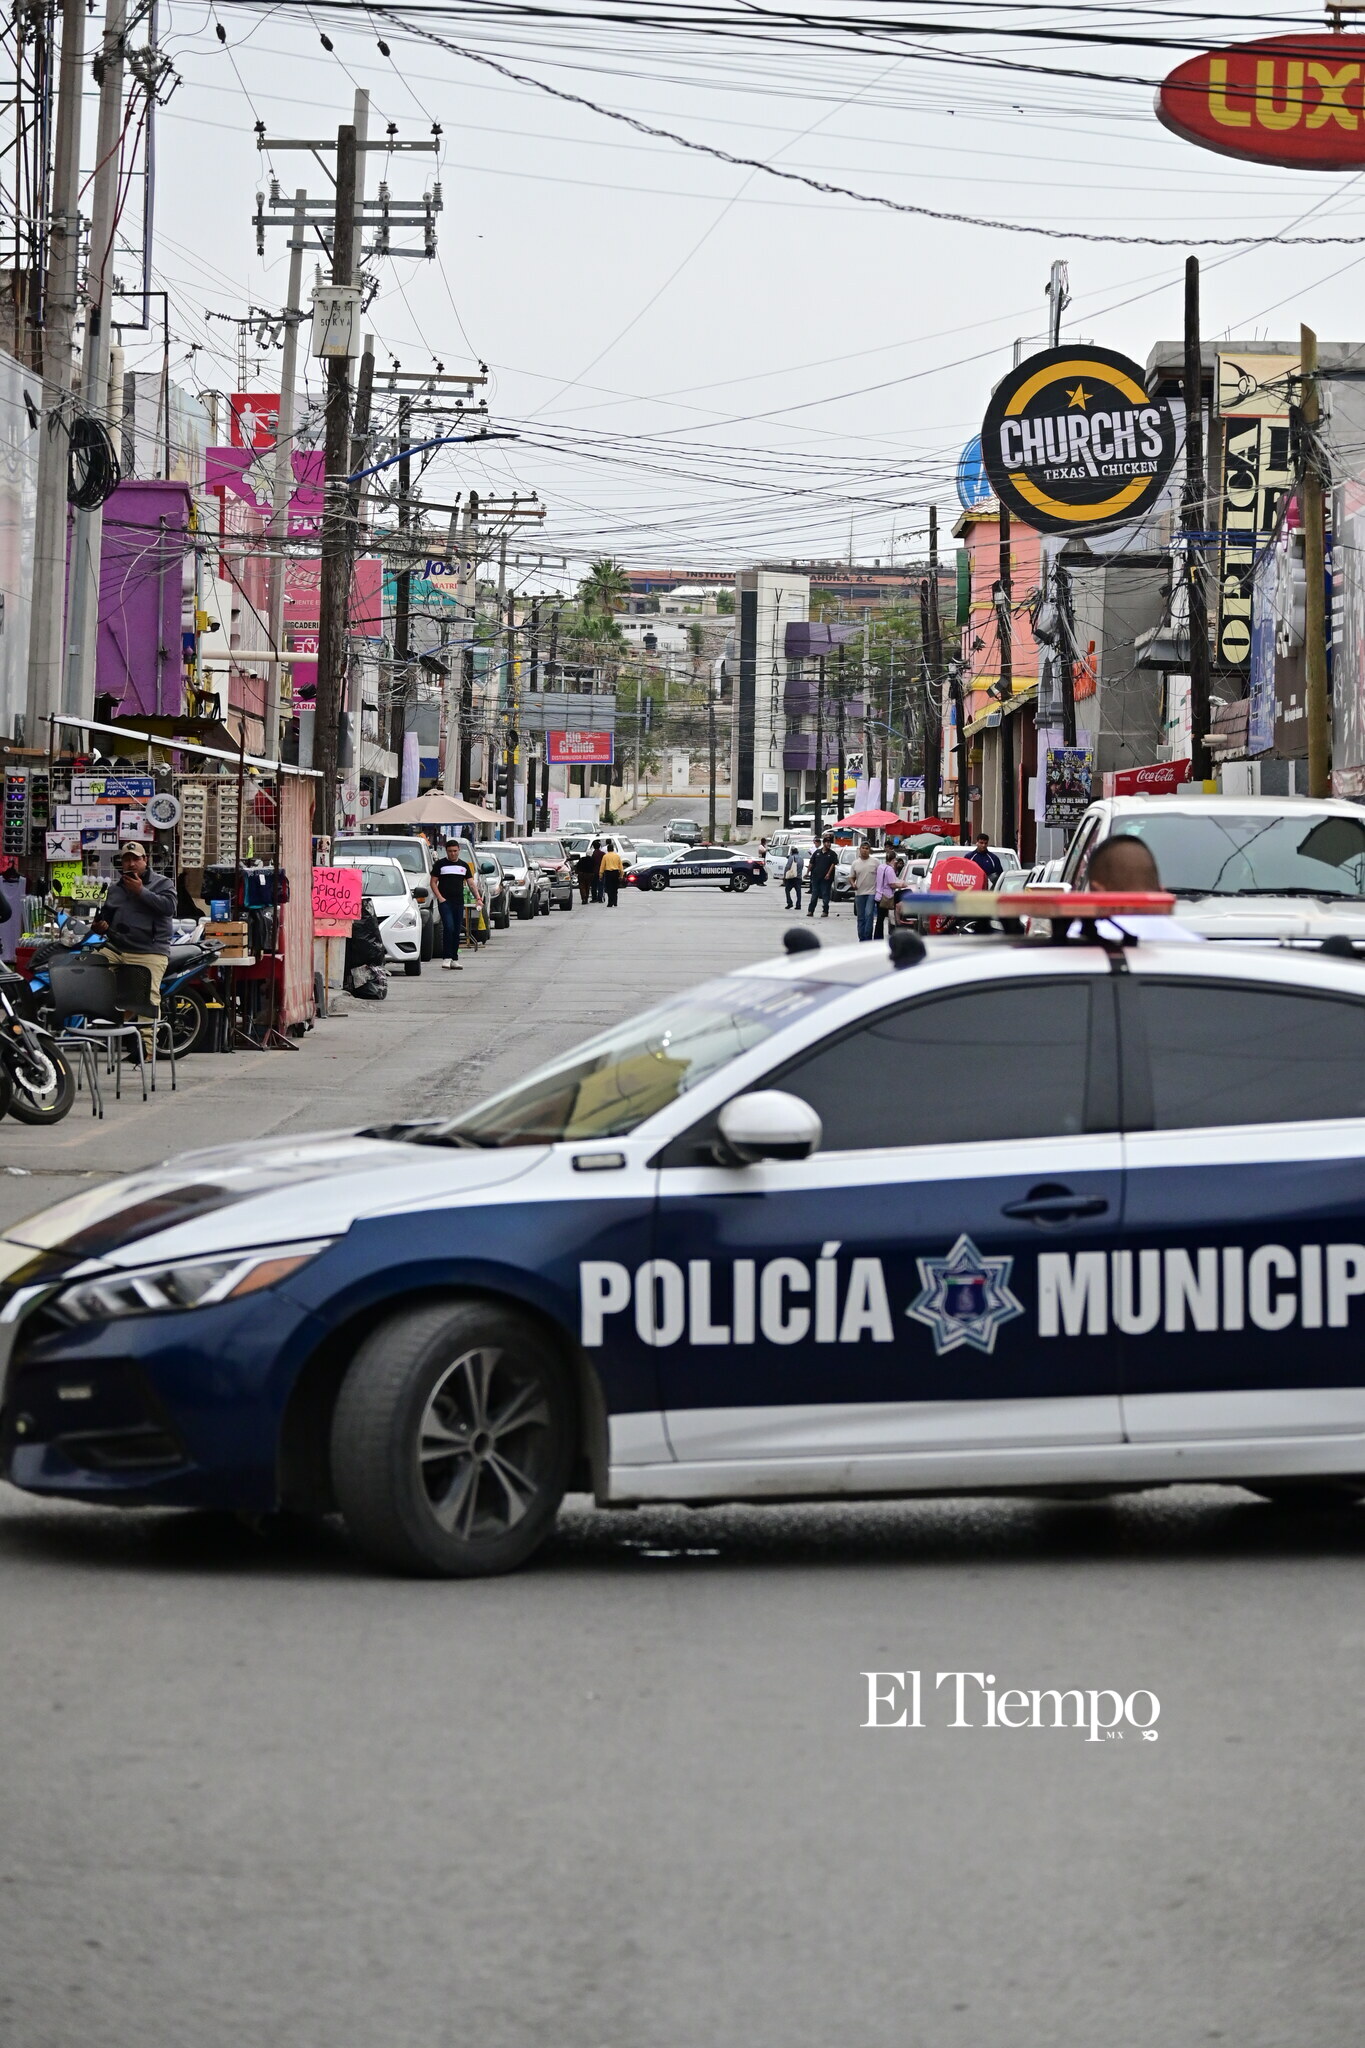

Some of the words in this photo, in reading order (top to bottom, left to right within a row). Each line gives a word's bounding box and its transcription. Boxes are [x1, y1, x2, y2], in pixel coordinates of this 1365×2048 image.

[1208, 59, 1365, 130] LUX
[1000, 408, 1163, 477] CHURCH'S
[1044, 467, 1085, 480] TEXAS
[1101, 461, 1158, 477] CHICKEN
[668, 866, 692, 876] POLICÍA
[701, 867, 734, 875] MUNICIPAL
[946, 872, 977, 886] CHURCH'S
[579, 1240, 894, 1347] POLICÍA
[1038, 1244, 1365, 1337] MUNICIP
